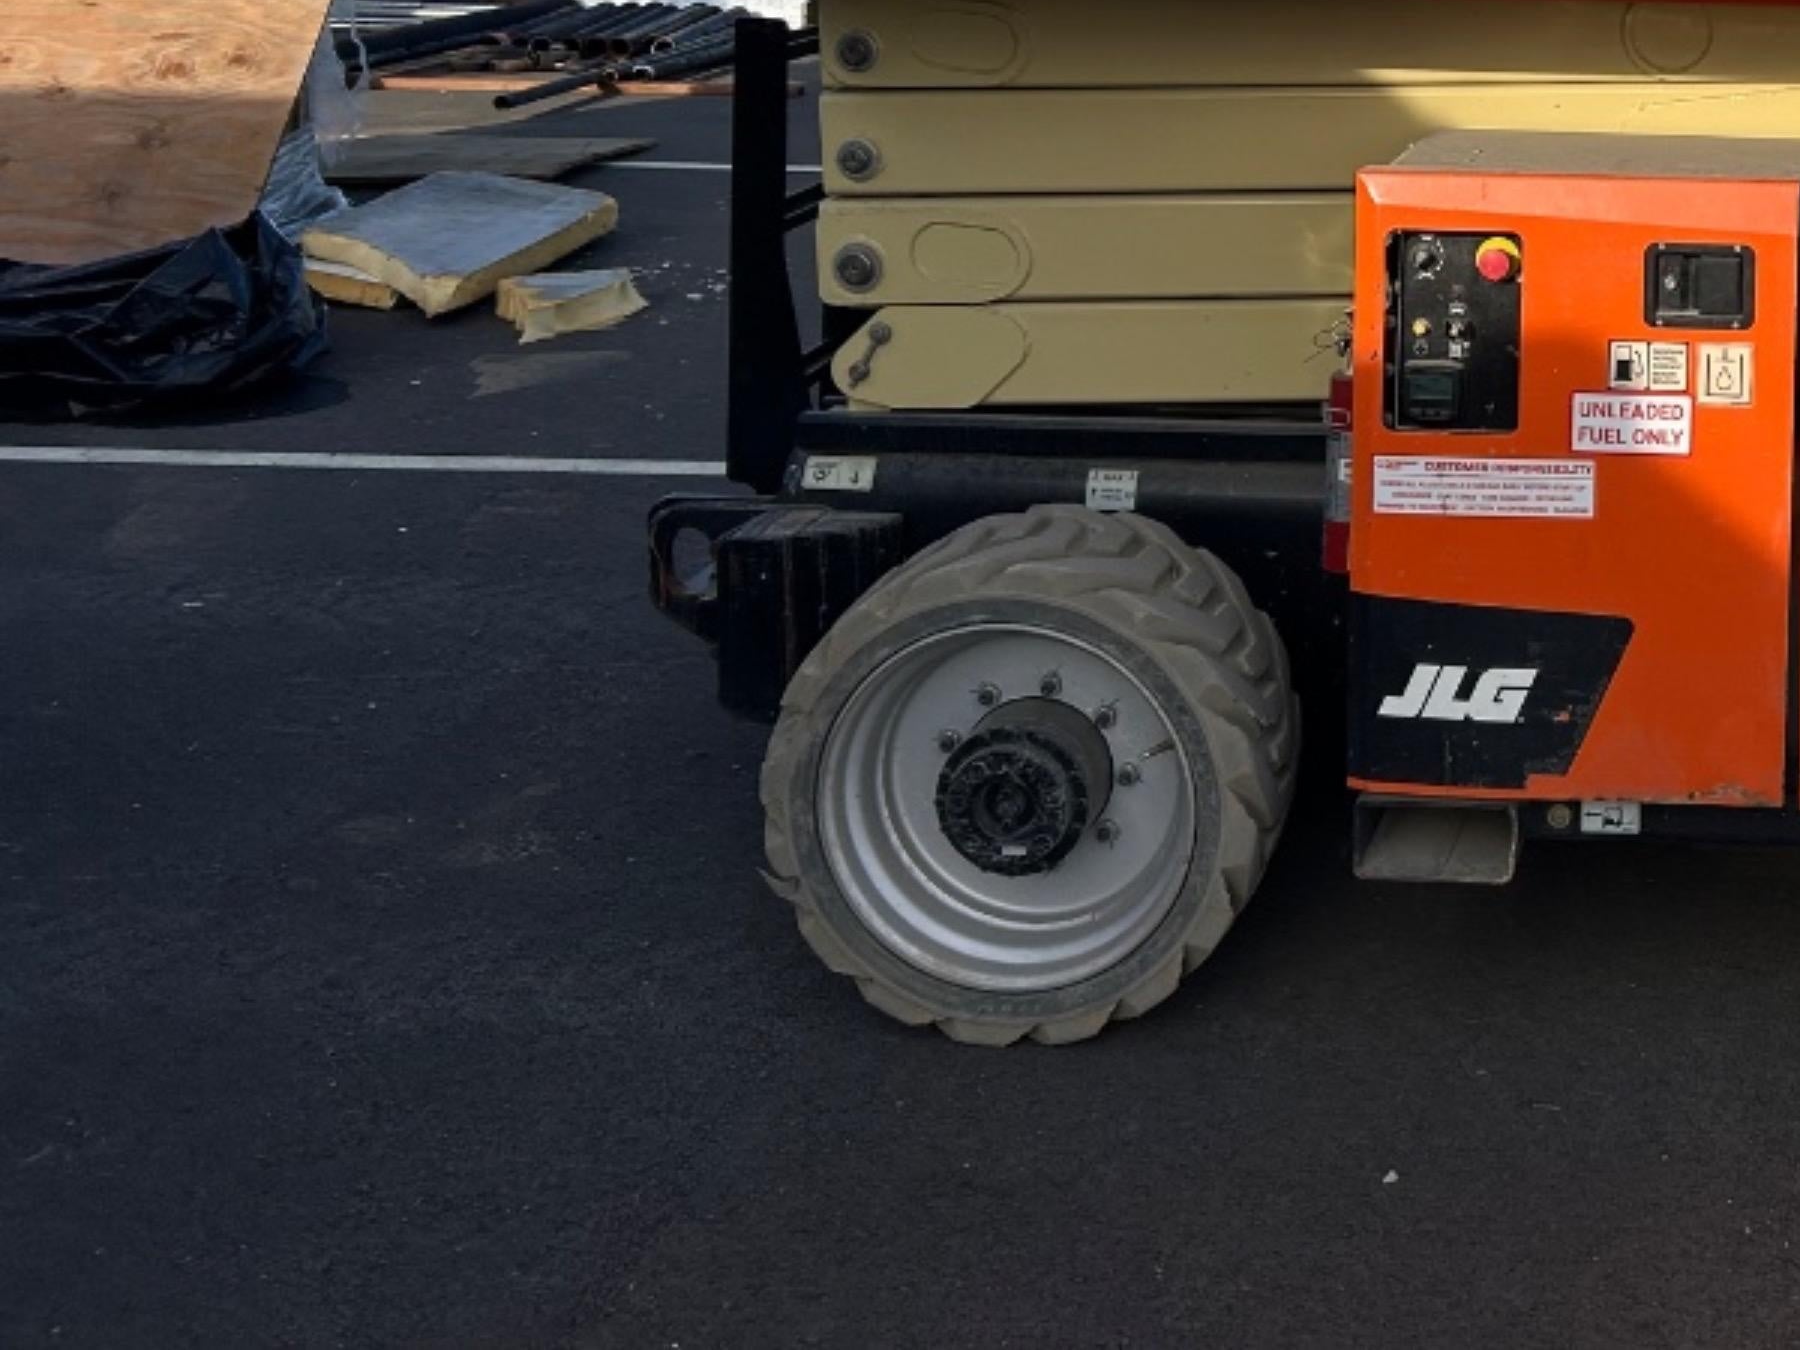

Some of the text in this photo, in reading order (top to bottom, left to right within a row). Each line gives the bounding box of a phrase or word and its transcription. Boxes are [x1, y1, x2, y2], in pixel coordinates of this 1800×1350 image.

[1579, 402, 1685, 421] UNLEADED
[1577, 426, 1684, 446] FUEL ONLY
[1377, 662, 1539, 723] JLG
